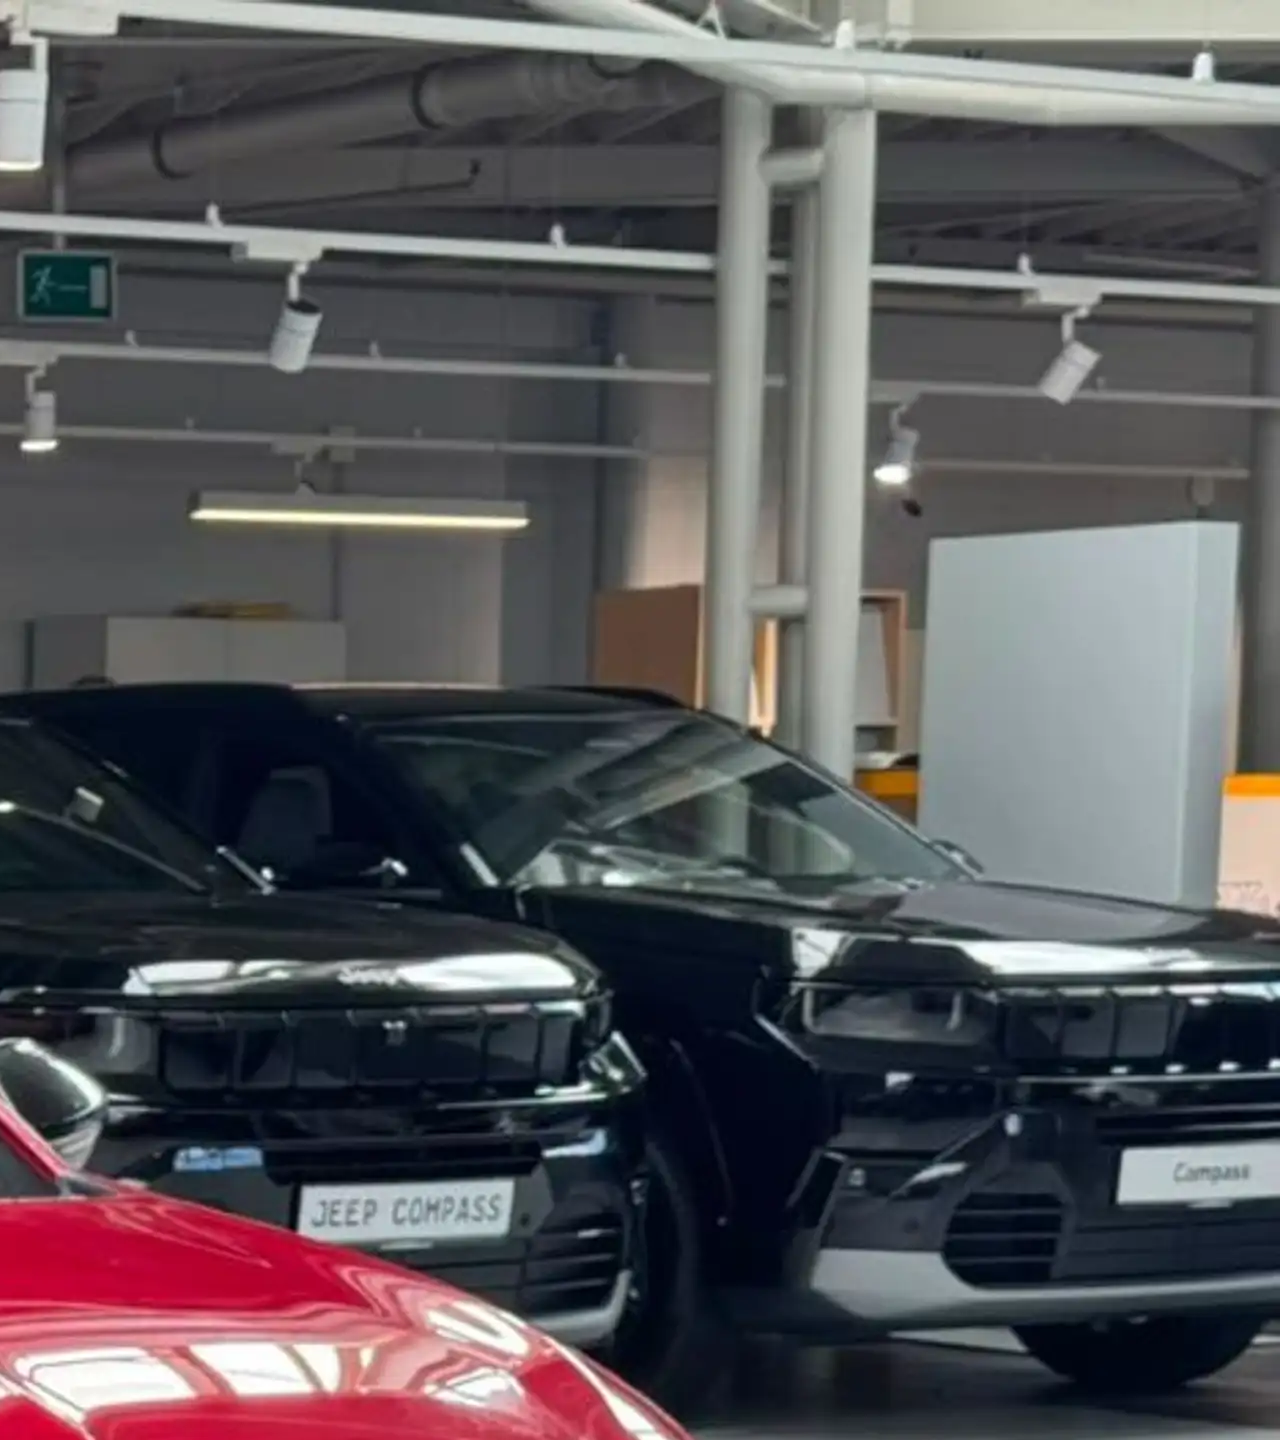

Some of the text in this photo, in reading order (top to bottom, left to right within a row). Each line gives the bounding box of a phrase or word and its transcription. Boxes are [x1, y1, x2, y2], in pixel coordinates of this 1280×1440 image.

[1172, 1161, 1251, 1185] Compass
[310, 1193, 503, 1228] JEEP COMPASS
